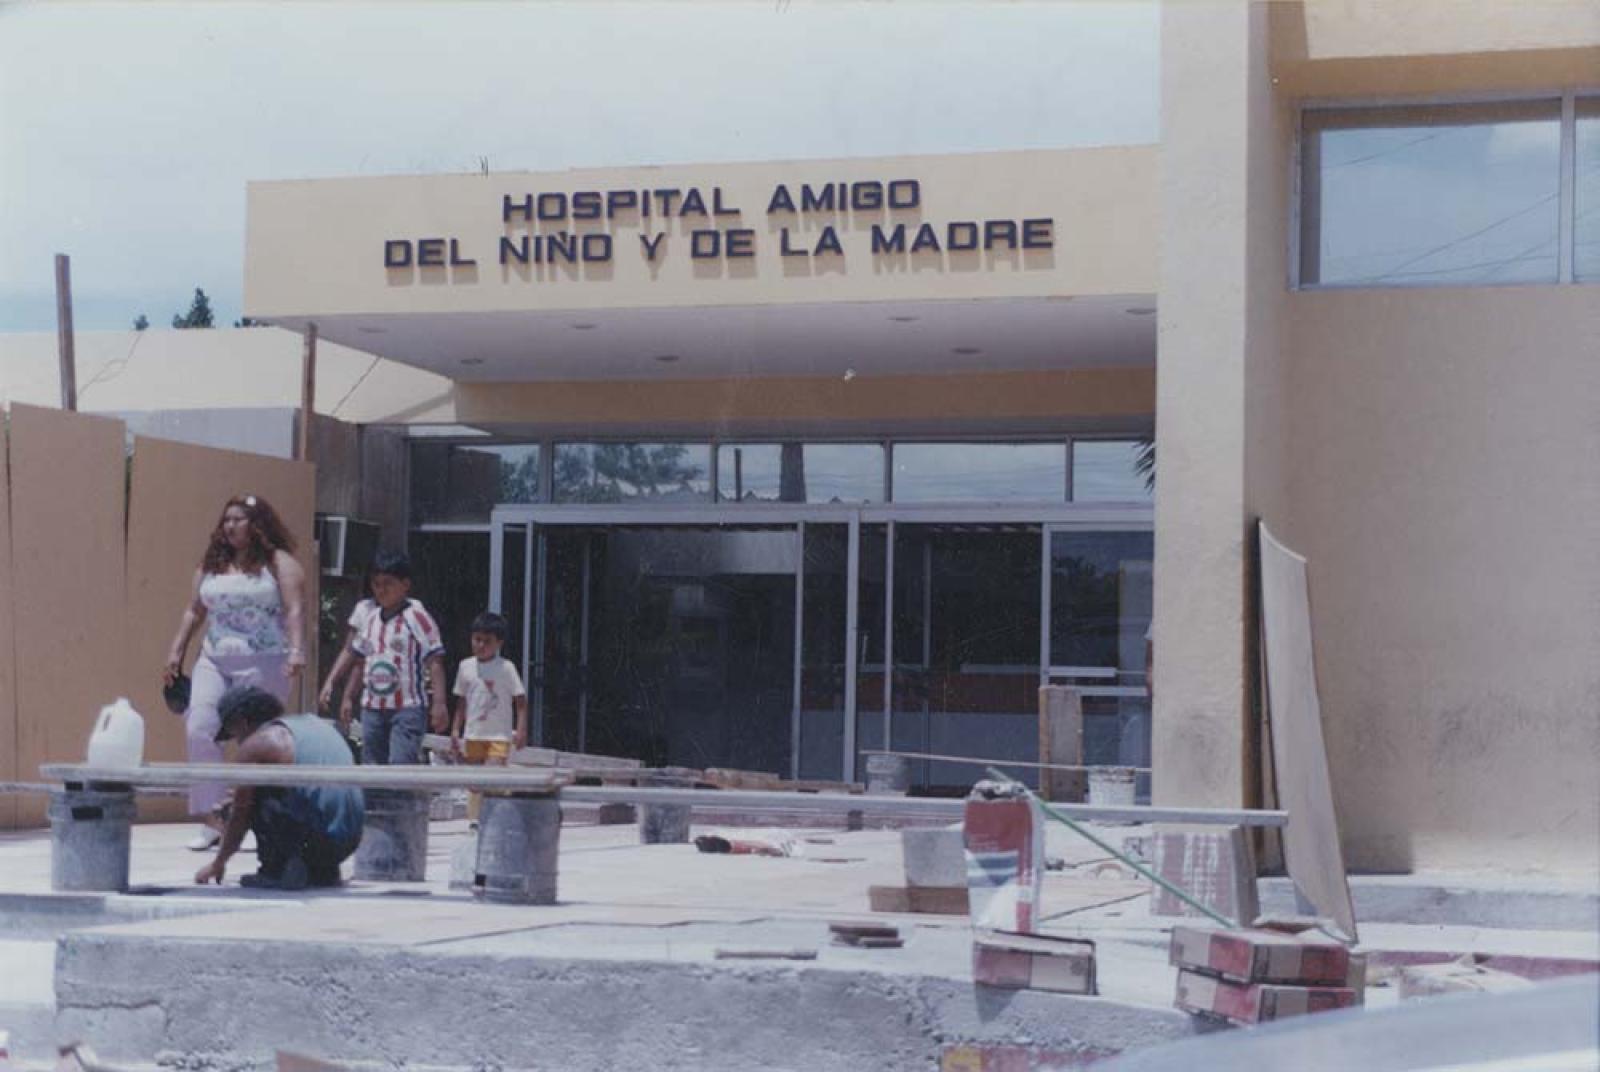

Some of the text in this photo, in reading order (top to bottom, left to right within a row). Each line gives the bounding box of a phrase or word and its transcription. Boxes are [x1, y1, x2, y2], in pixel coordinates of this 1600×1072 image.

[503, 179, 921, 224] HOSPITAL AMIGO
[384, 238, 477, 269] DEL
[639, 231, 665, 262] Y
[690, 228, 756, 260] DE
[780, 225, 844, 257] LA
[871, 217, 1054, 255] MADRE
